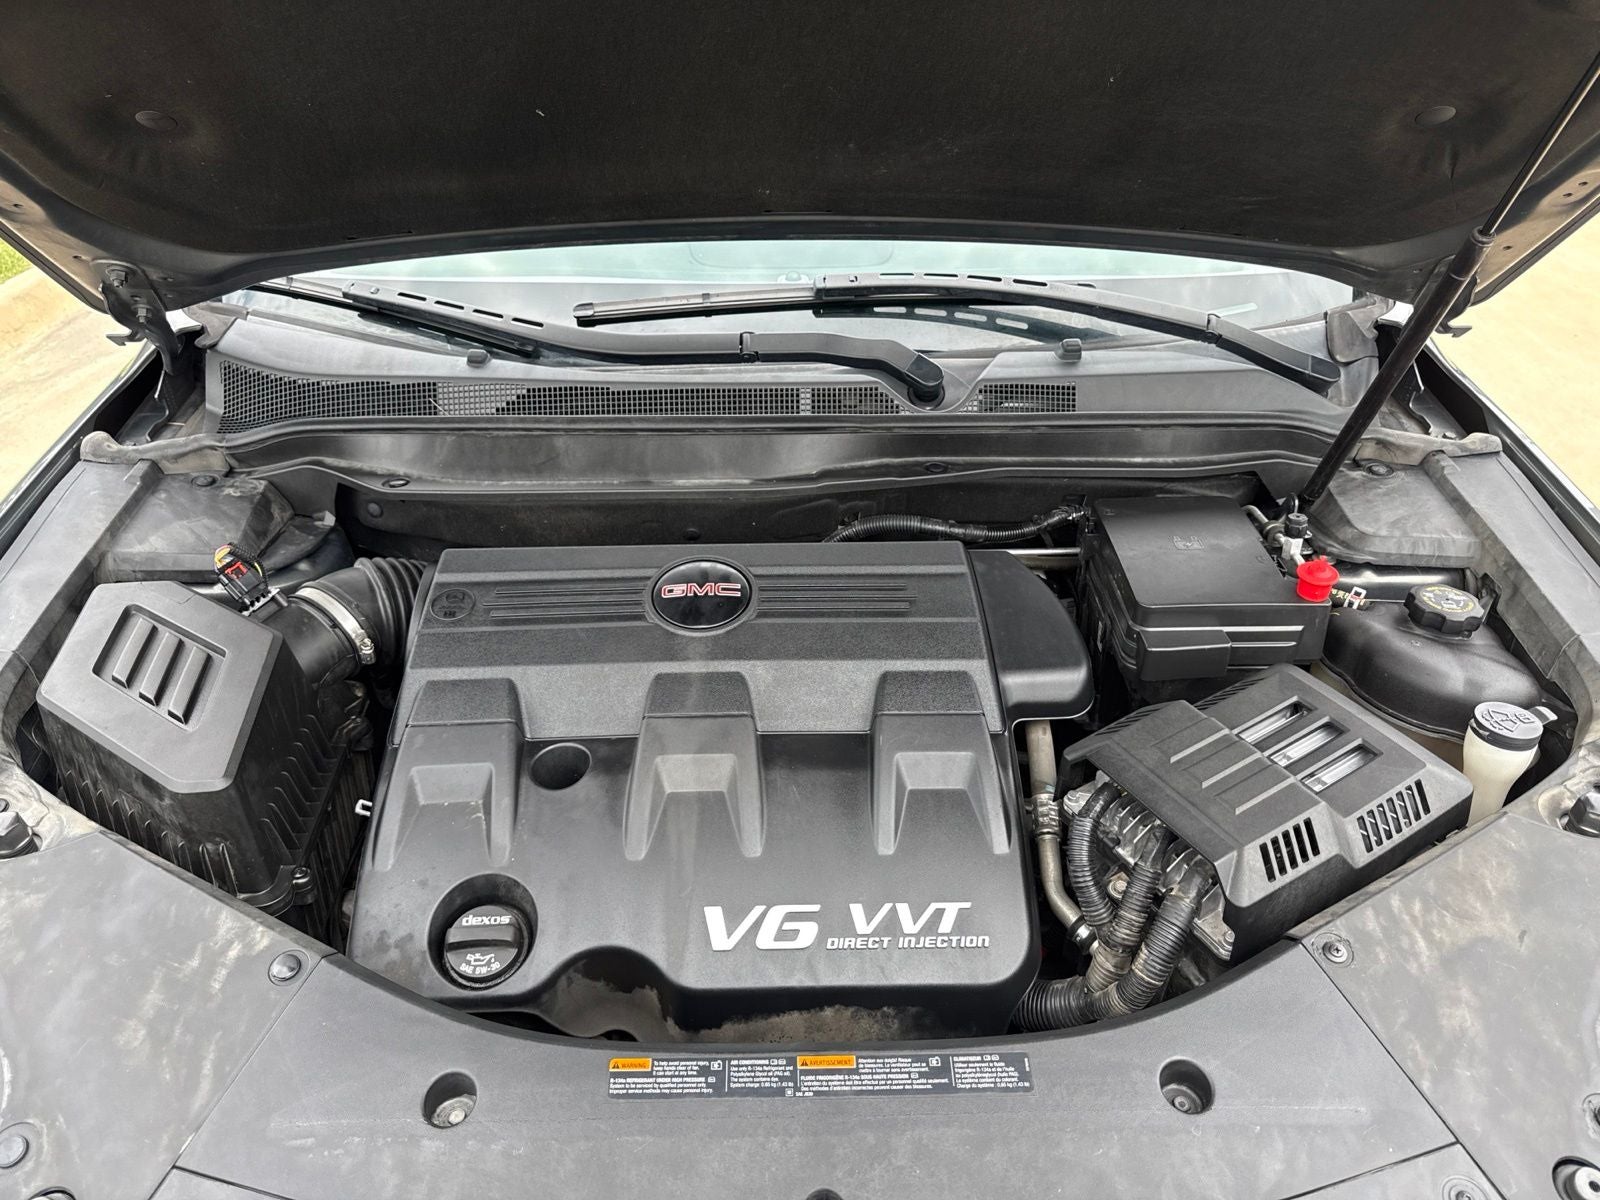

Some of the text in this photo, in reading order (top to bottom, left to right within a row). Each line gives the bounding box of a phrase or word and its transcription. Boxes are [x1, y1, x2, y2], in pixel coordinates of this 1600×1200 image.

[661, 582, 742, 599] GMC
[462, 915, 512, 926] dexos
[704, 902, 972, 951] V6 VVT
[826, 936, 892, 950] DIRECT
[460, 962, 500, 974] SAE 5W-30
